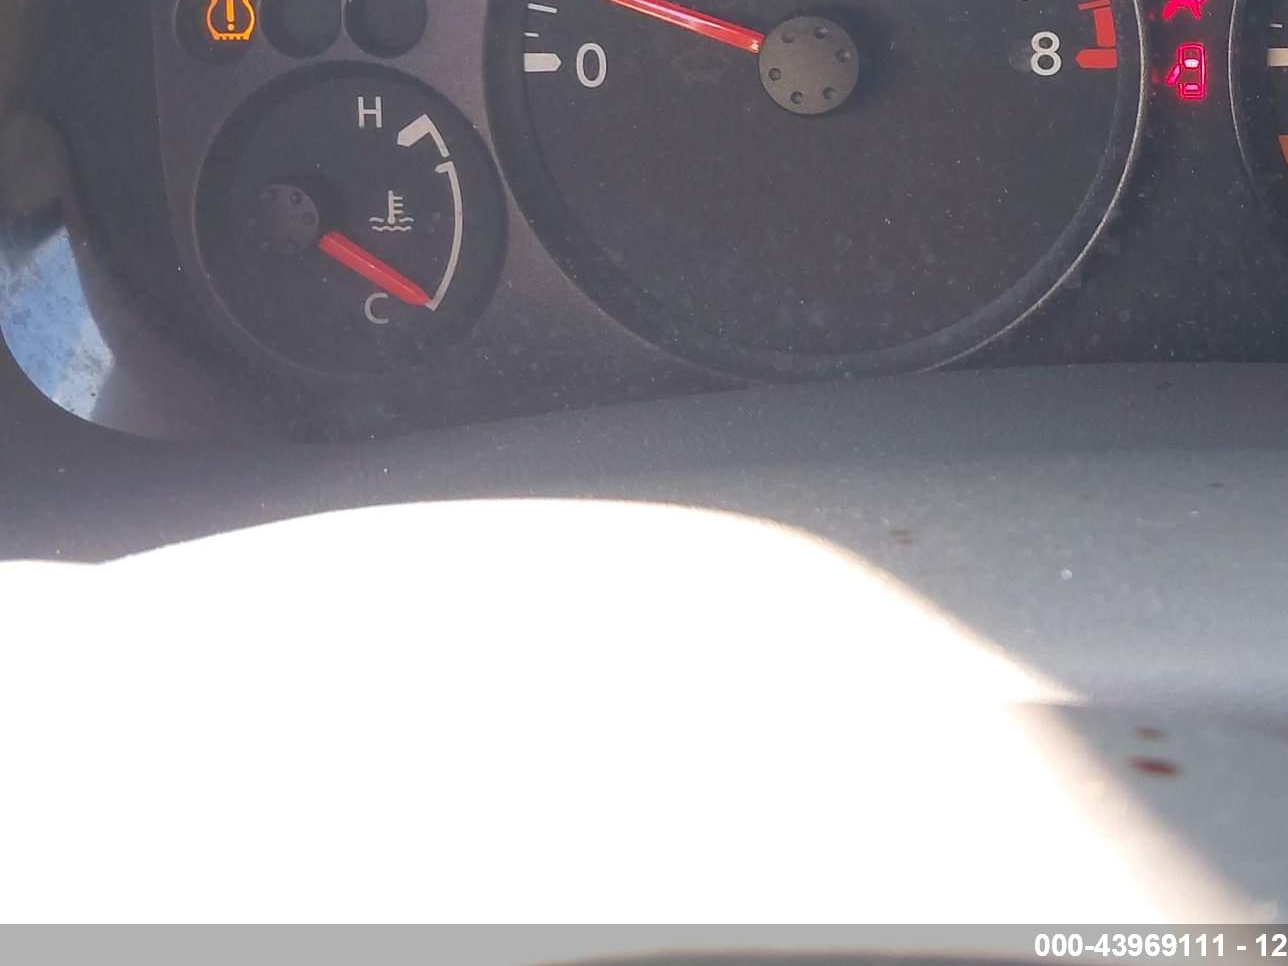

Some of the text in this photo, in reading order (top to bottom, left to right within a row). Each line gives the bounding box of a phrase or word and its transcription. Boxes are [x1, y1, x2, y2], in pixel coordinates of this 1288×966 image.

[576, 42, 607, 88] 0
[1030, 31, 1062, 76] 8
[357, 96, 383, 128] H
[364, 292, 389, 324] C
